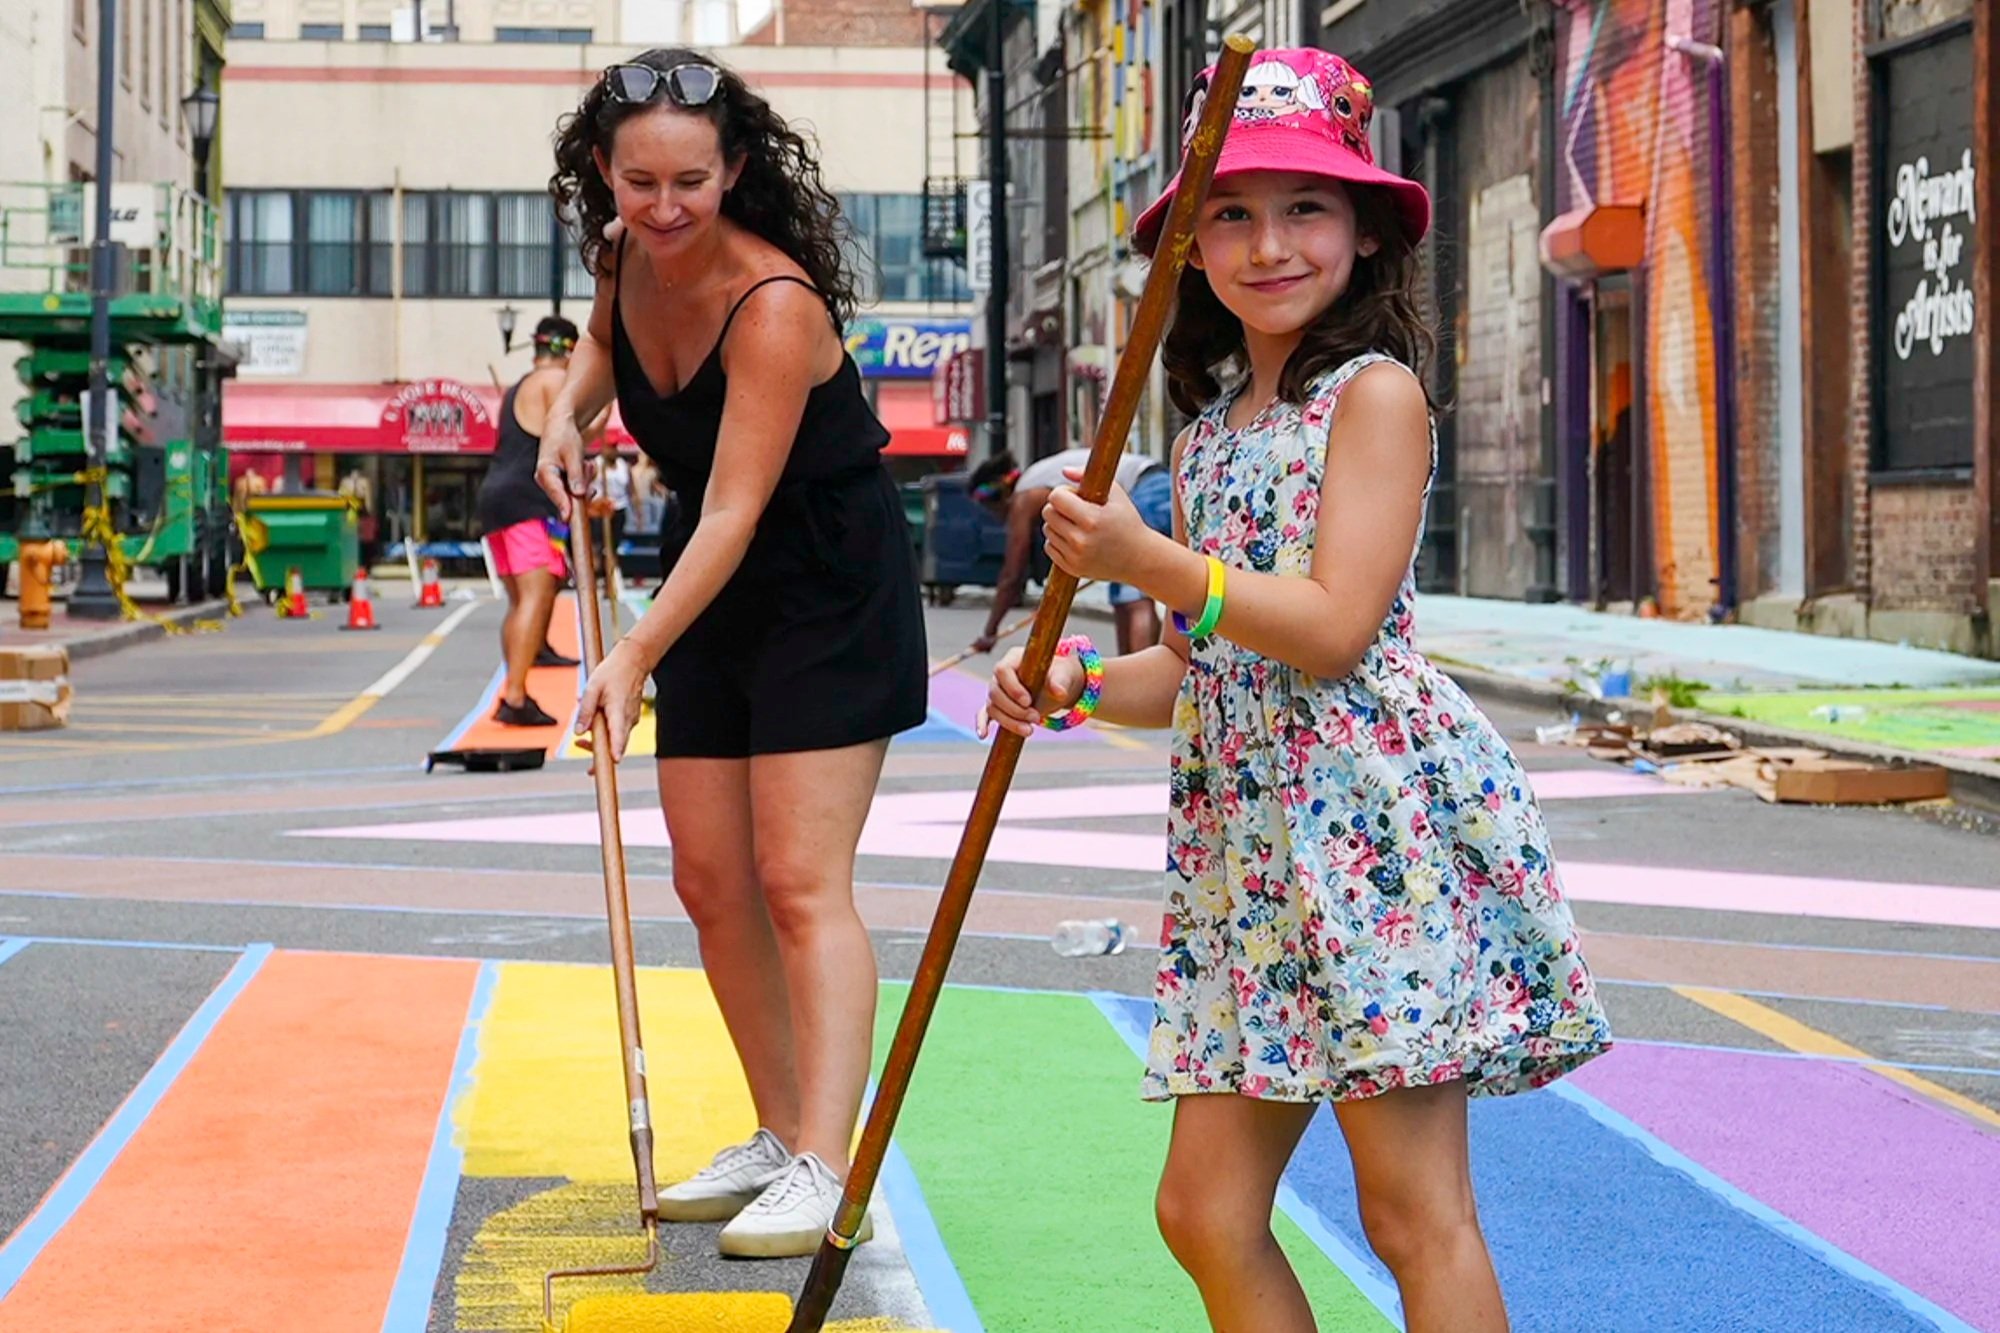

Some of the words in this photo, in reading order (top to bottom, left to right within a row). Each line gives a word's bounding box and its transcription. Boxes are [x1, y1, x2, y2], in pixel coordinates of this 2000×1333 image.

[109, 208, 139, 221] LG
[1888, 148, 1975, 247] Newark
[1923, 227, 1938, 271] is
[1936, 222, 1963, 280] for
[1895, 277, 1974, 360] Artists
